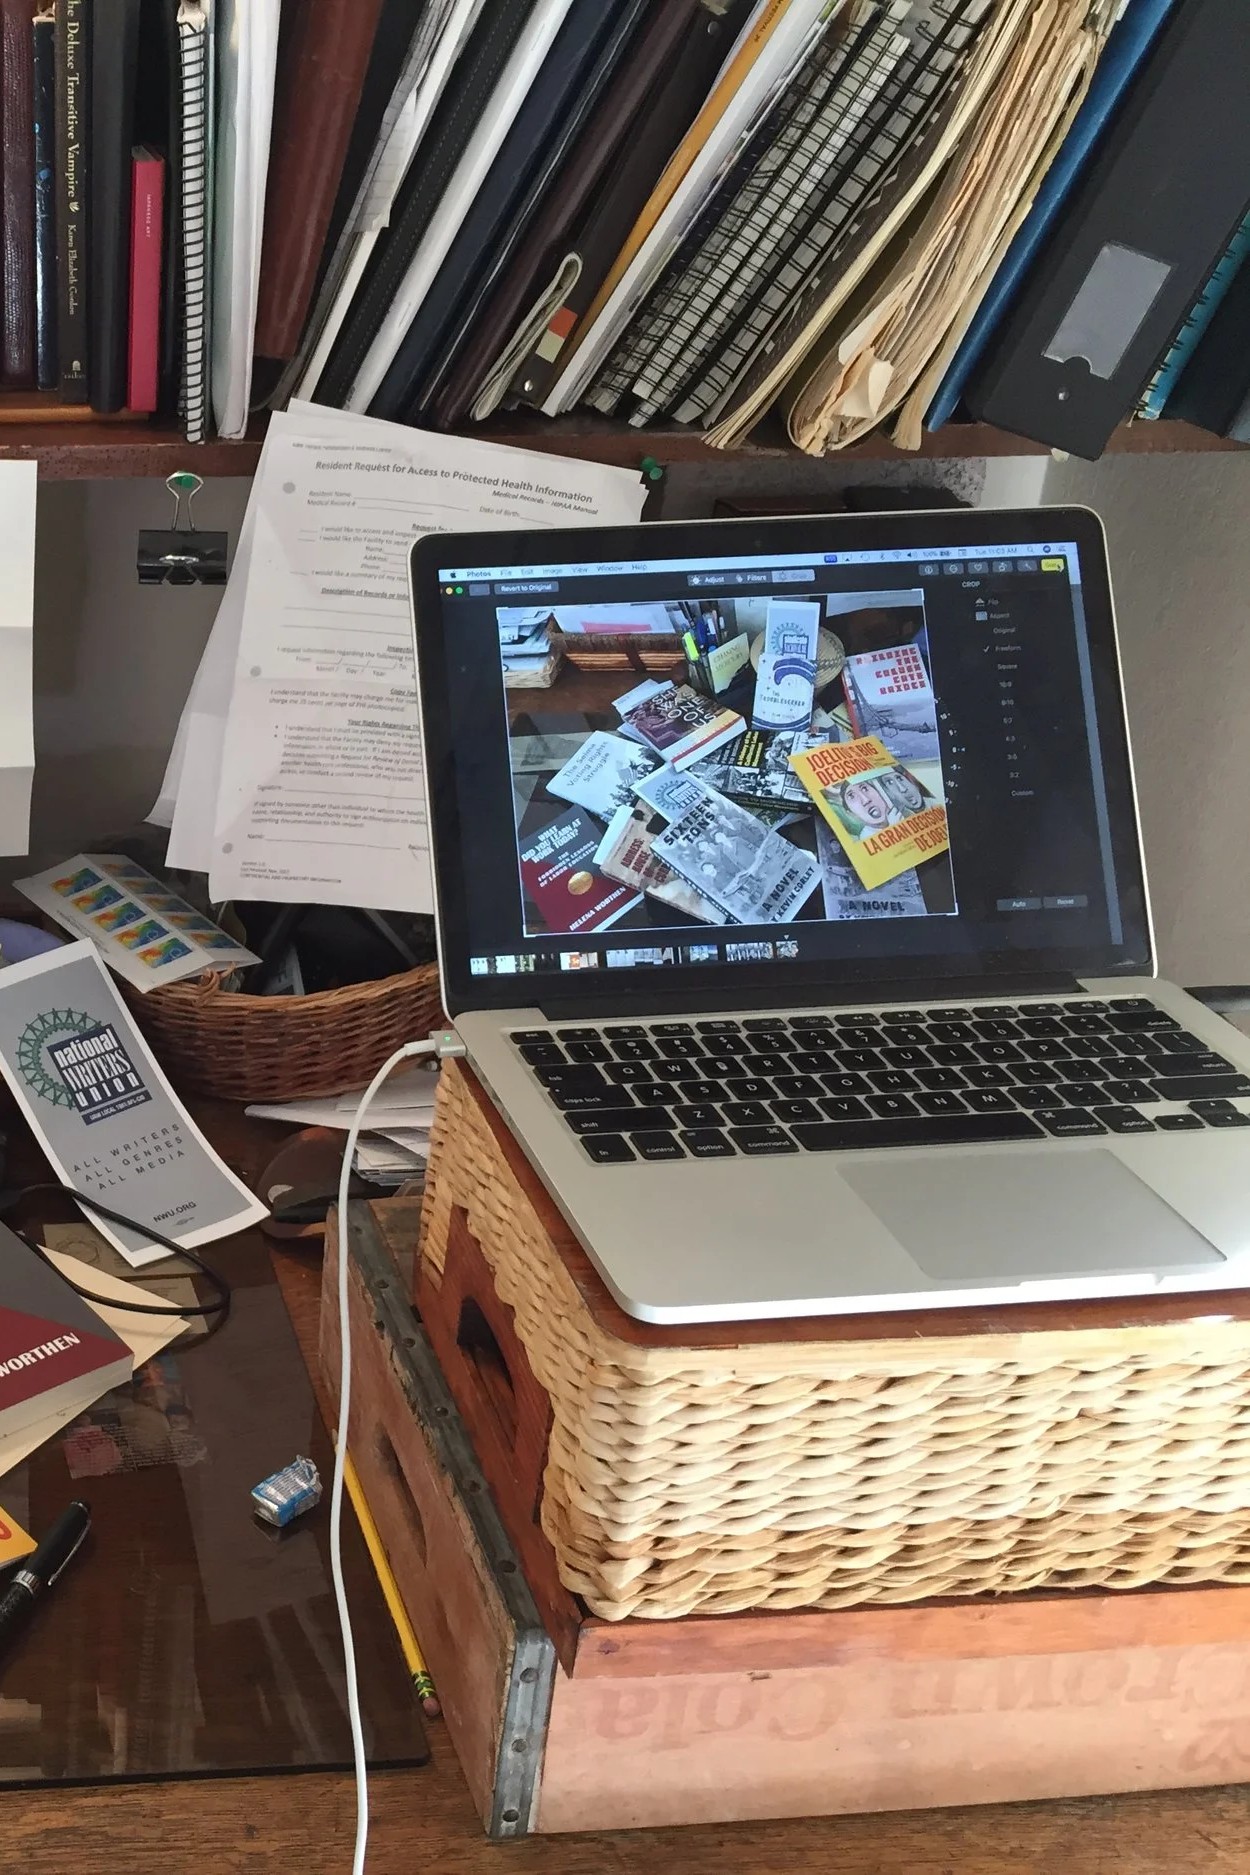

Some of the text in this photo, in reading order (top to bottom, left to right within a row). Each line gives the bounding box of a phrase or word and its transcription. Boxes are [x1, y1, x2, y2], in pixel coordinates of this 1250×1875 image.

[65, 21, 80, 200] Deluxe Transitive Vampire
[315, 461, 593, 504] Resident Request for Access to Protected Health Information
[961, 580, 980, 588] CROP
[663, 796, 715, 846] SIXTEEN
[682, 811, 716, 845] TONS
[53, 1028, 119, 1069] national
[62, 1048, 131, 1092] WRITERS
[75, 1071, 140, 1107] union
[73, 1123, 180, 1173] ALL WRITERS
[85, 1136, 183, 1182] ALL GENRES
[98, 1150, 185, 1190] ALL MEDIA
[152, 1201, 197, 1223] NWU.ORG
